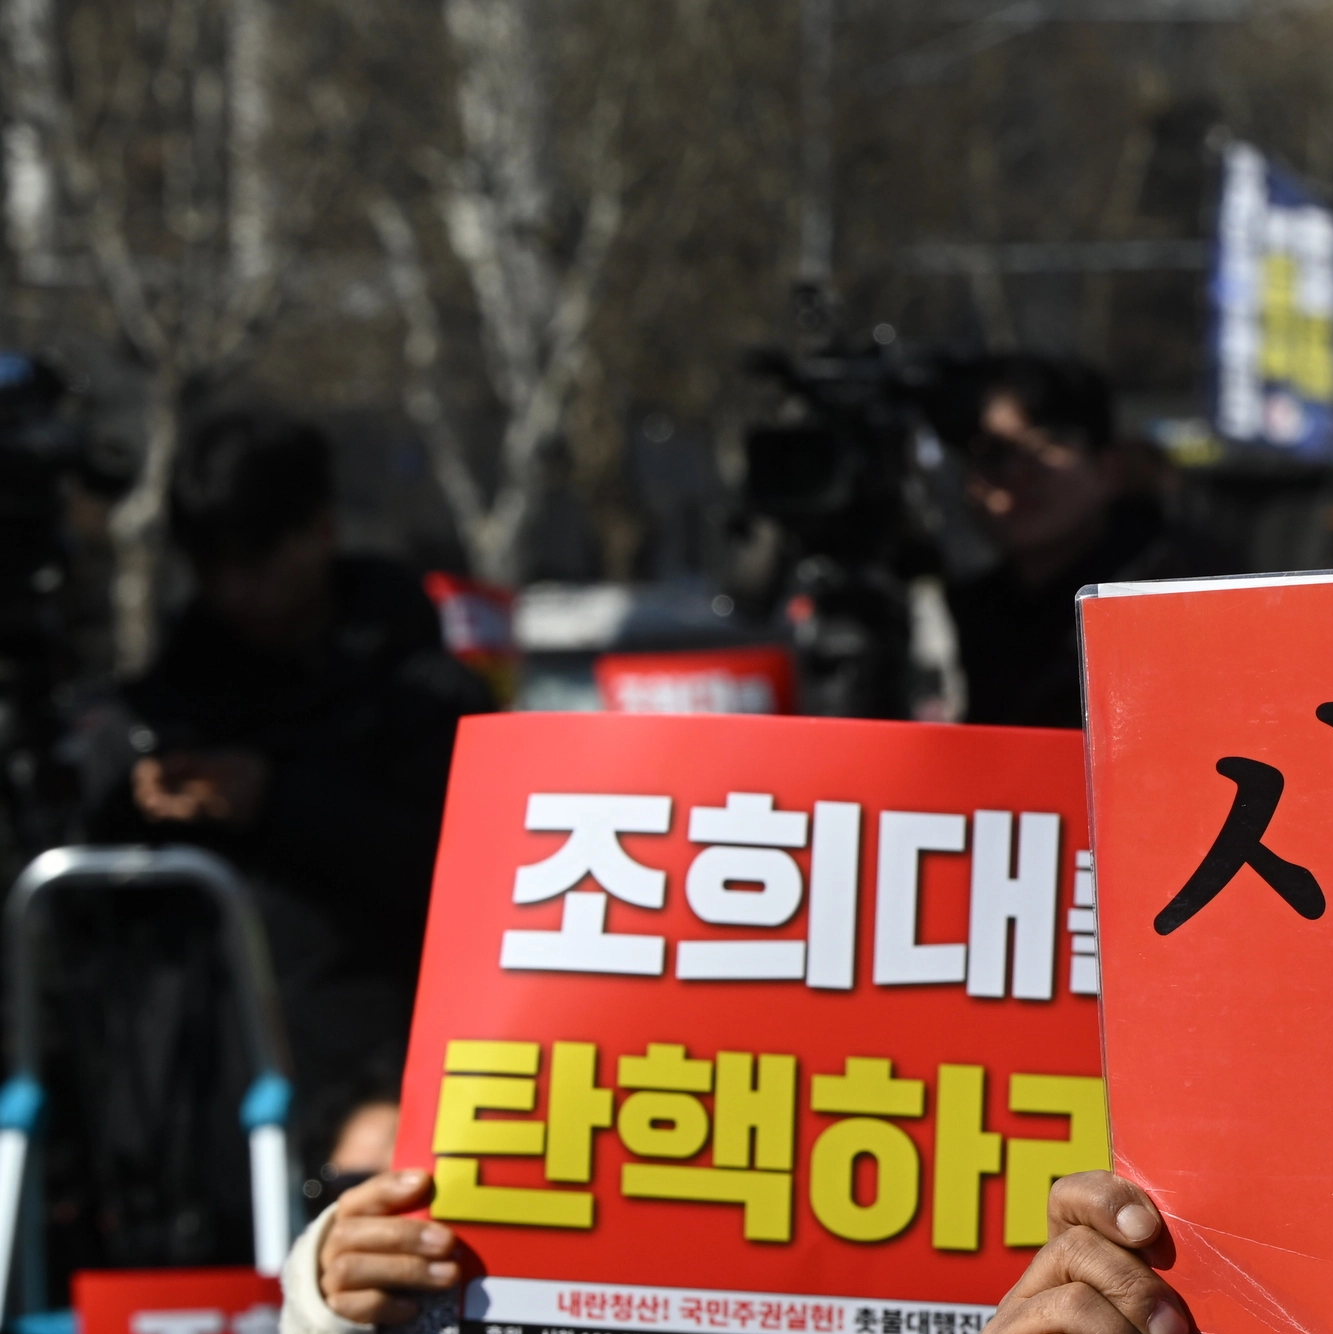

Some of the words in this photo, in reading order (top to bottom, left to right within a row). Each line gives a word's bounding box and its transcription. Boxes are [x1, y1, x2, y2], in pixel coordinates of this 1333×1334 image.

[500, 792, 1098, 1000] 조희대
[557, 1291, 670, 1323] 내란청산!
[679, 1296, 845, 1332] 국민주권실현!
